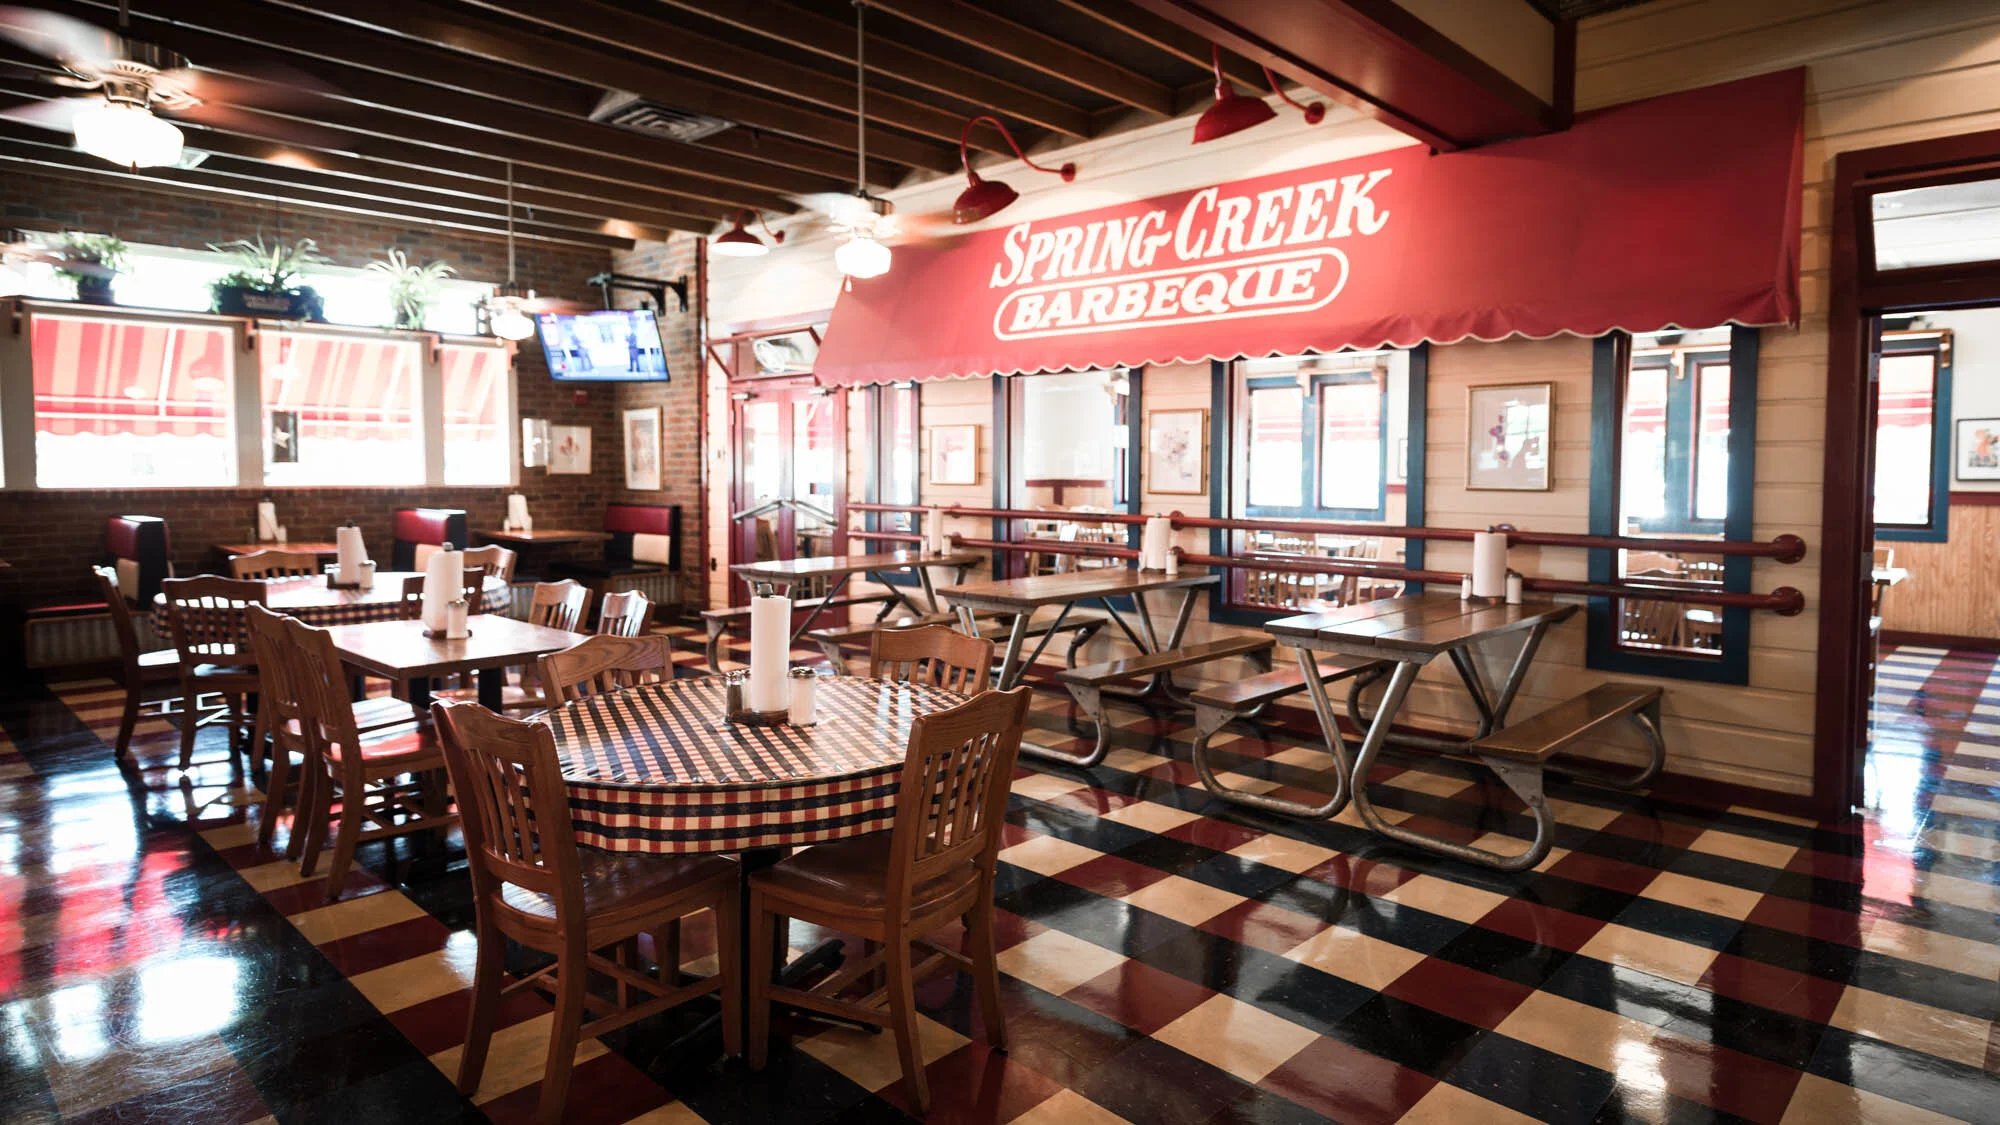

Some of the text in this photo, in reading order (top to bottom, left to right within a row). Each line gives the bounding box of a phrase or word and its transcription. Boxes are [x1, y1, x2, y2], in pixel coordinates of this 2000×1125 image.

[990, 169, 1392, 288] SPRING CREEK
[1009, 260, 1321, 332] BARBEQUE
